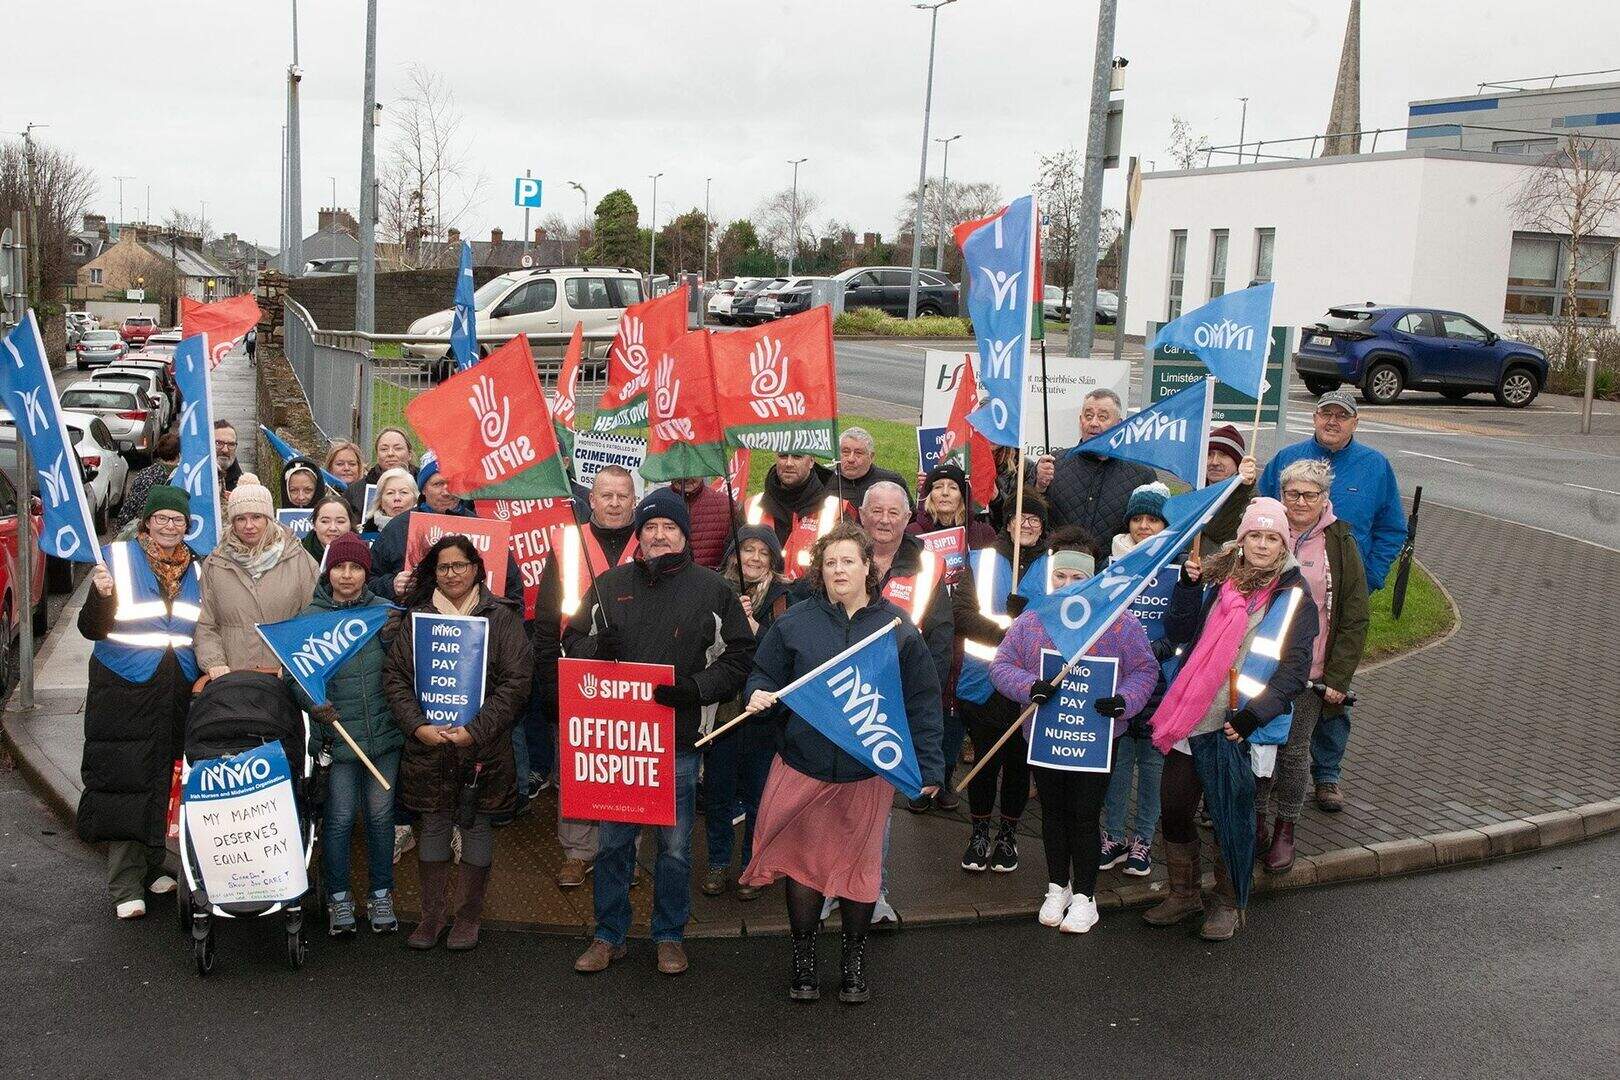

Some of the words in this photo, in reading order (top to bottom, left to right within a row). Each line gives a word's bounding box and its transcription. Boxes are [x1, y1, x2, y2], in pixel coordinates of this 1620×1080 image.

[519, 180, 538, 205] P
[575, 448, 641, 468] CRIMEWATCH
[934, 535, 957, 549] SIPTU
[1134, 595, 1169, 606] EDOC
[432, 622, 462, 638] INMO
[291, 616, 369, 678] INMO
[431, 641, 460, 654] FAIR
[431, 659, 458, 670] PAY
[430, 675, 456, 688] FOR
[1060, 679, 1089, 693] FAIR
[600, 679, 653, 701] SIPTU
[421, 692, 469, 705] NURSES
[1060, 696, 1087, 710] PAY
[426, 709, 459, 722] NOW
[826, 664, 903, 770] INMO
[1058, 713, 1085, 726] FOR
[568, 716, 666, 753] OFFICIAL
[1045, 726, 1096, 742] NURSES
[1051, 744, 1087, 758] NOW
[201, 755, 271, 791] INMO
[575, 752, 660, 787] DISPUTE
[202, 813, 220, 827] MY
[231, 798, 278, 823] MAMMY
[592, 802, 645, 813] www.siptu.ie
[213, 822, 279, 848] DESERVES
[212, 851, 253, 866] EQUAL
[264, 839, 289, 858] PAY
